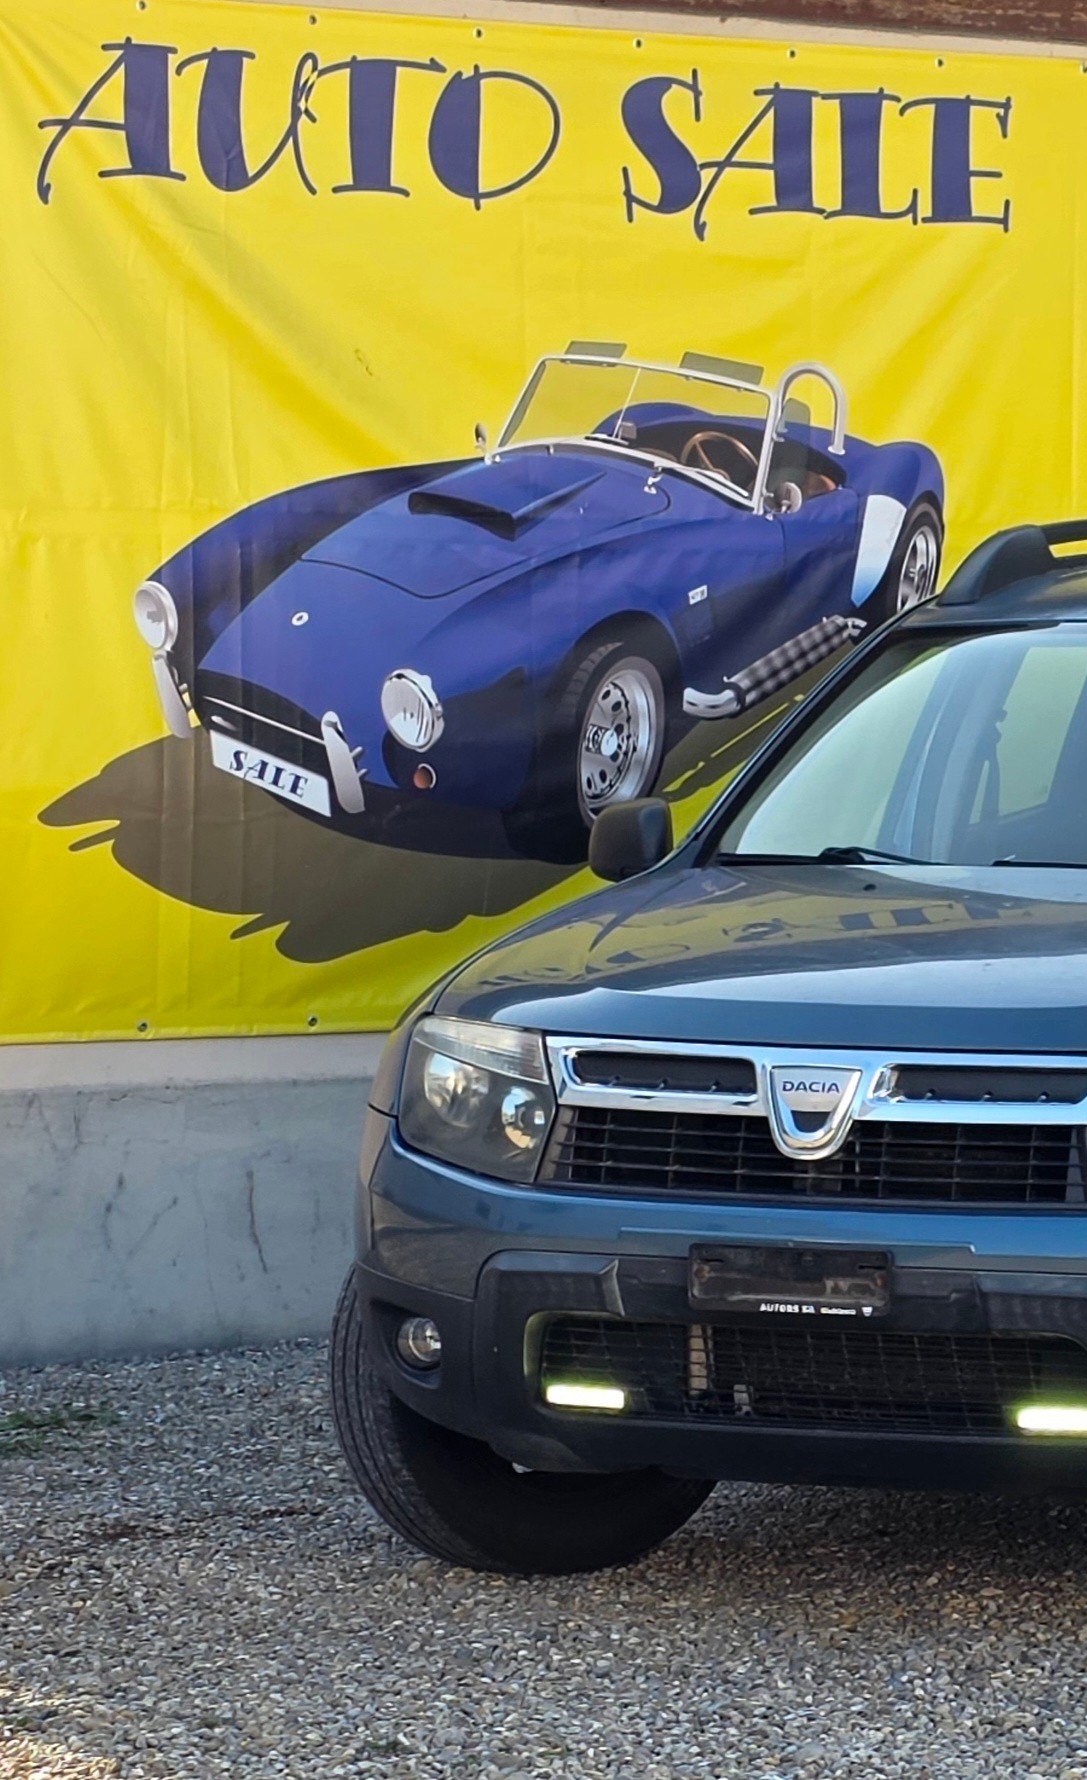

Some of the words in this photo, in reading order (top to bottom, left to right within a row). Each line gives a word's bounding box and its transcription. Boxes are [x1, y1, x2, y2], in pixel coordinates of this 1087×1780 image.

[38, 37, 561, 211] AUTO
[622, 69, 1012, 242] SALE
[230, 750, 309, 798] SALE
[782, 1081, 840, 1094] DACIA
